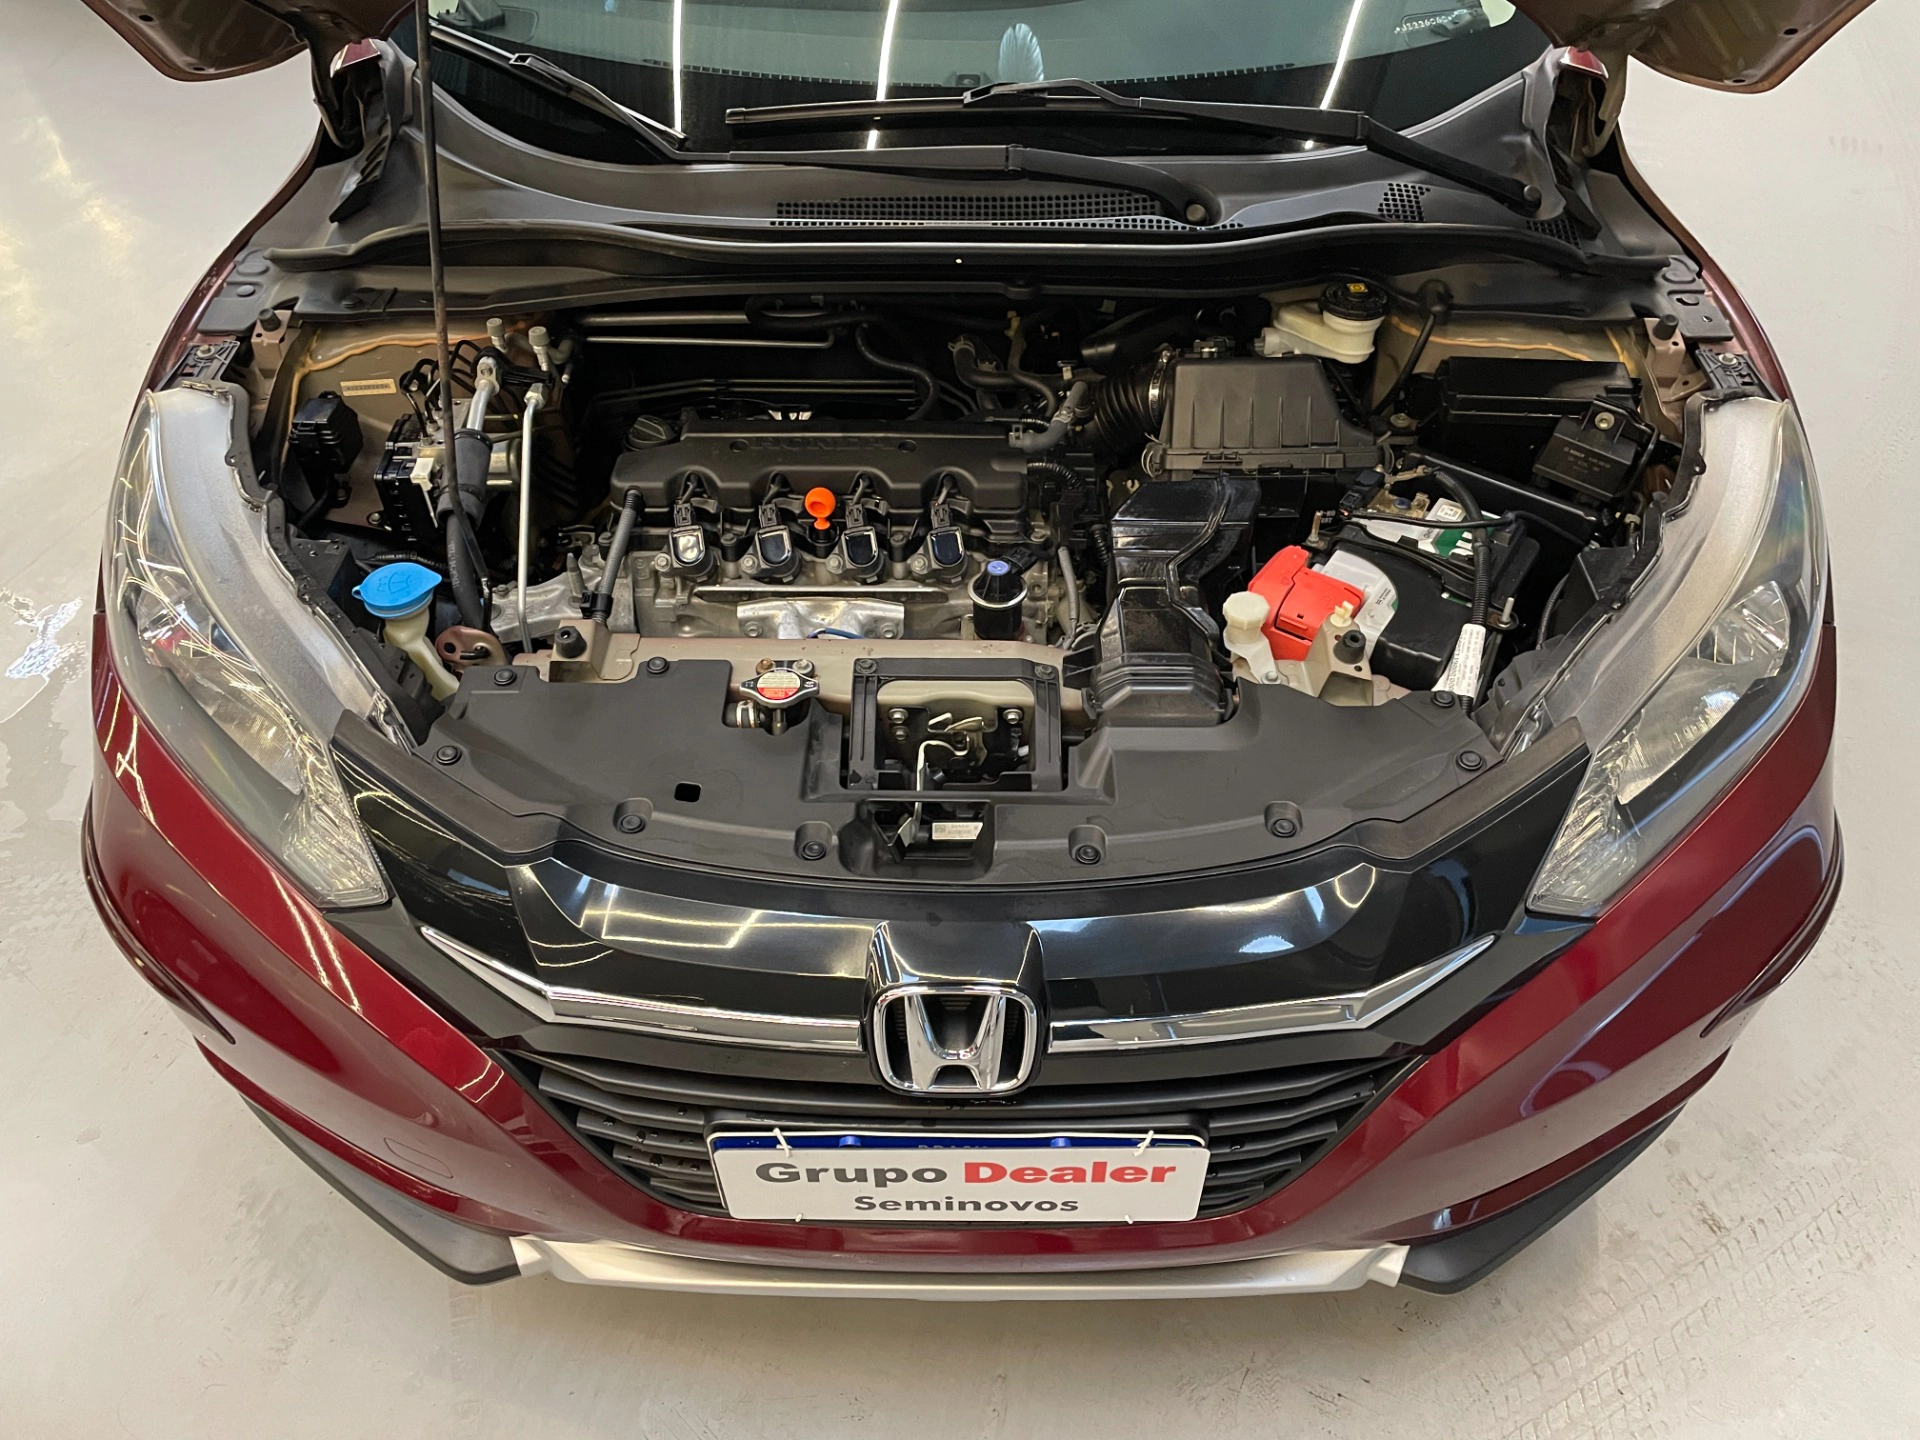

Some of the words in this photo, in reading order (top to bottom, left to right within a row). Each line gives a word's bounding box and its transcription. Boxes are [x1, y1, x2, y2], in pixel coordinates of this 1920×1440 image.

[755, 1161, 948, 1189] Grupo
[964, 1161, 1177, 1184] Dealer
[854, 1195, 1079, 1213] Seminovos
